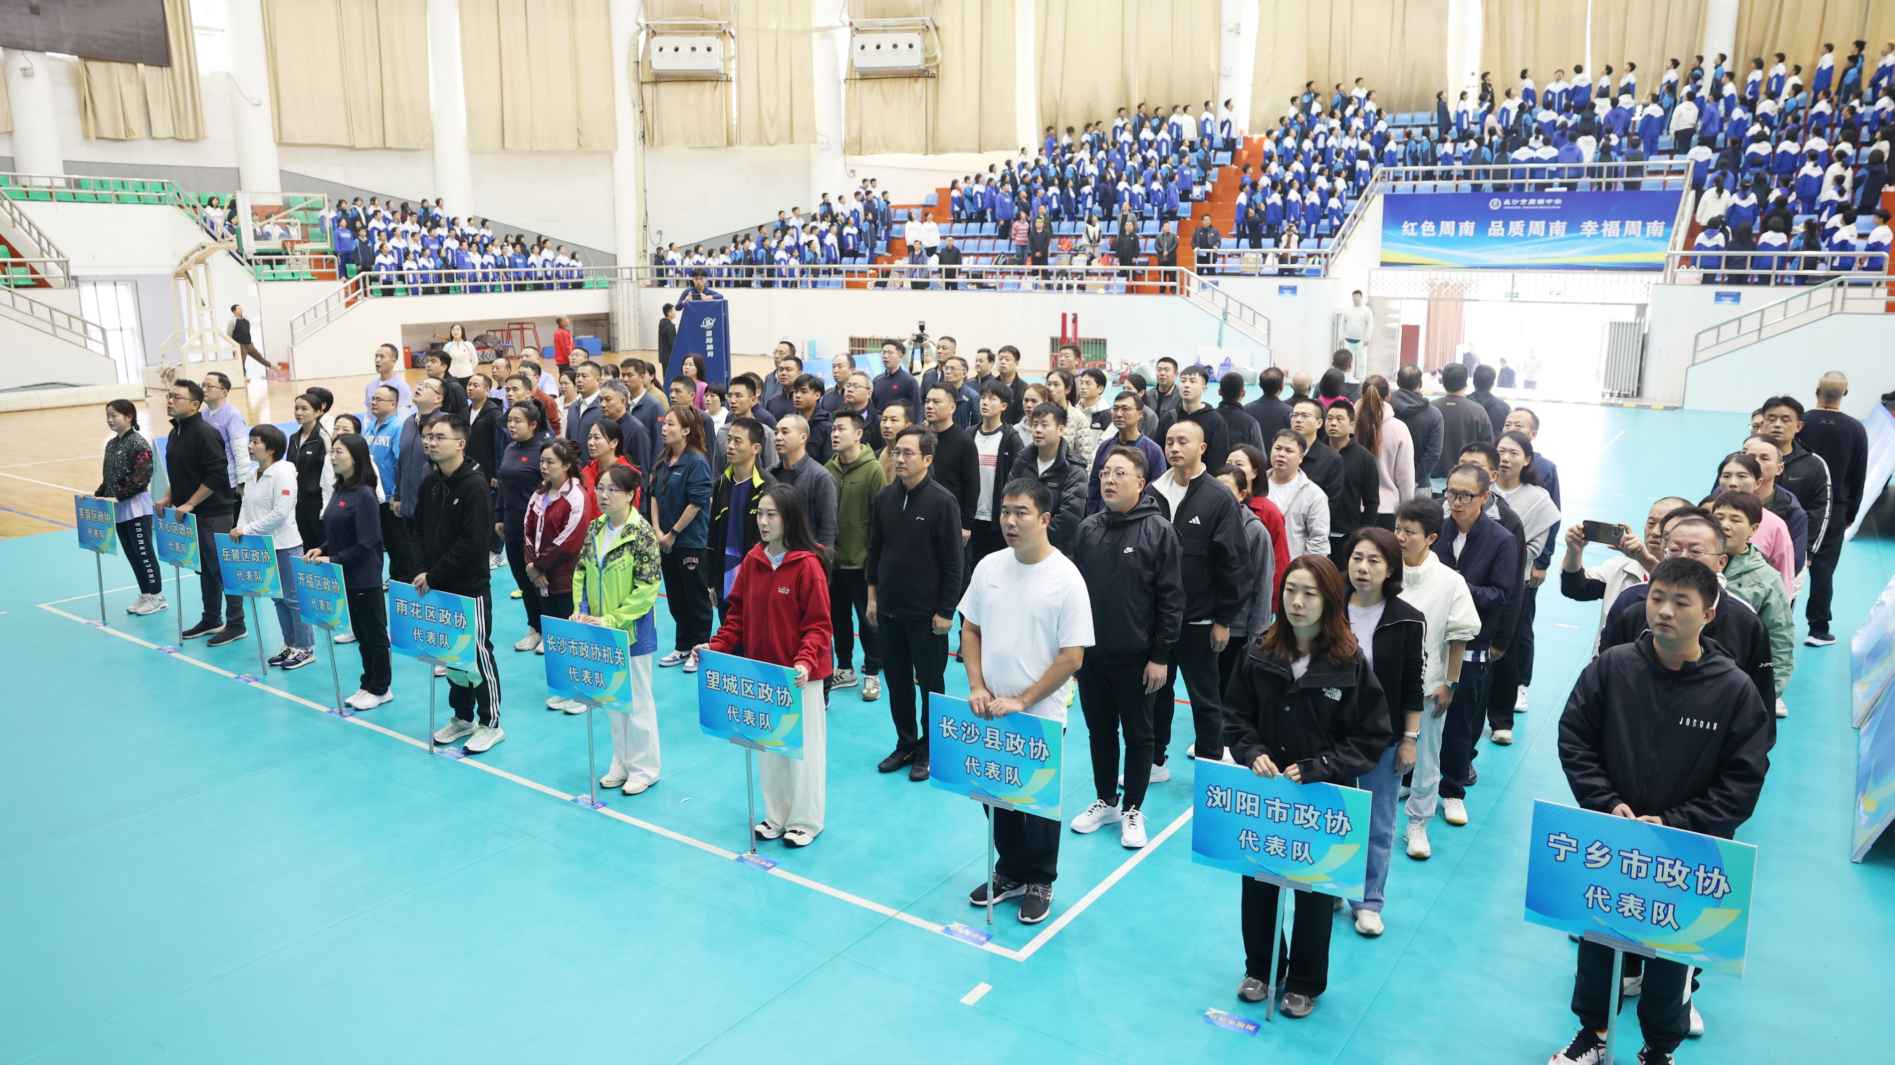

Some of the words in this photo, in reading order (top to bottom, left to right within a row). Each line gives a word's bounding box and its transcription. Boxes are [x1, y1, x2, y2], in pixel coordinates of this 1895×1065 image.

[1401, 220, 1476, 238] 红色周南
[1487, 219, 1568, 238] 品质周南
[1579, 219, 1666, 238] 幸福周南
[395, 598, 468, 630] 雨花区政协
[413, 628, 450, 650] 代表队
[545, 632, 626, 666] 长沙市政协机关
[568, 666, 607, 689] 代表队
[706, 670, 793, 708] 望城区政协
[727, 704, 774, 732] 代表队
[939, 716, 1051, 762] 长沙县政协
[965, 755, 1024, 788] 代表队
[1206, 784, 1352, 837] 浏阳市政协
[1238, 829, 1315, 865] 代表队
[1547, 832, 1732, 900] 宁乡市政协
[1585, 885, 1681, 931] 代表队
